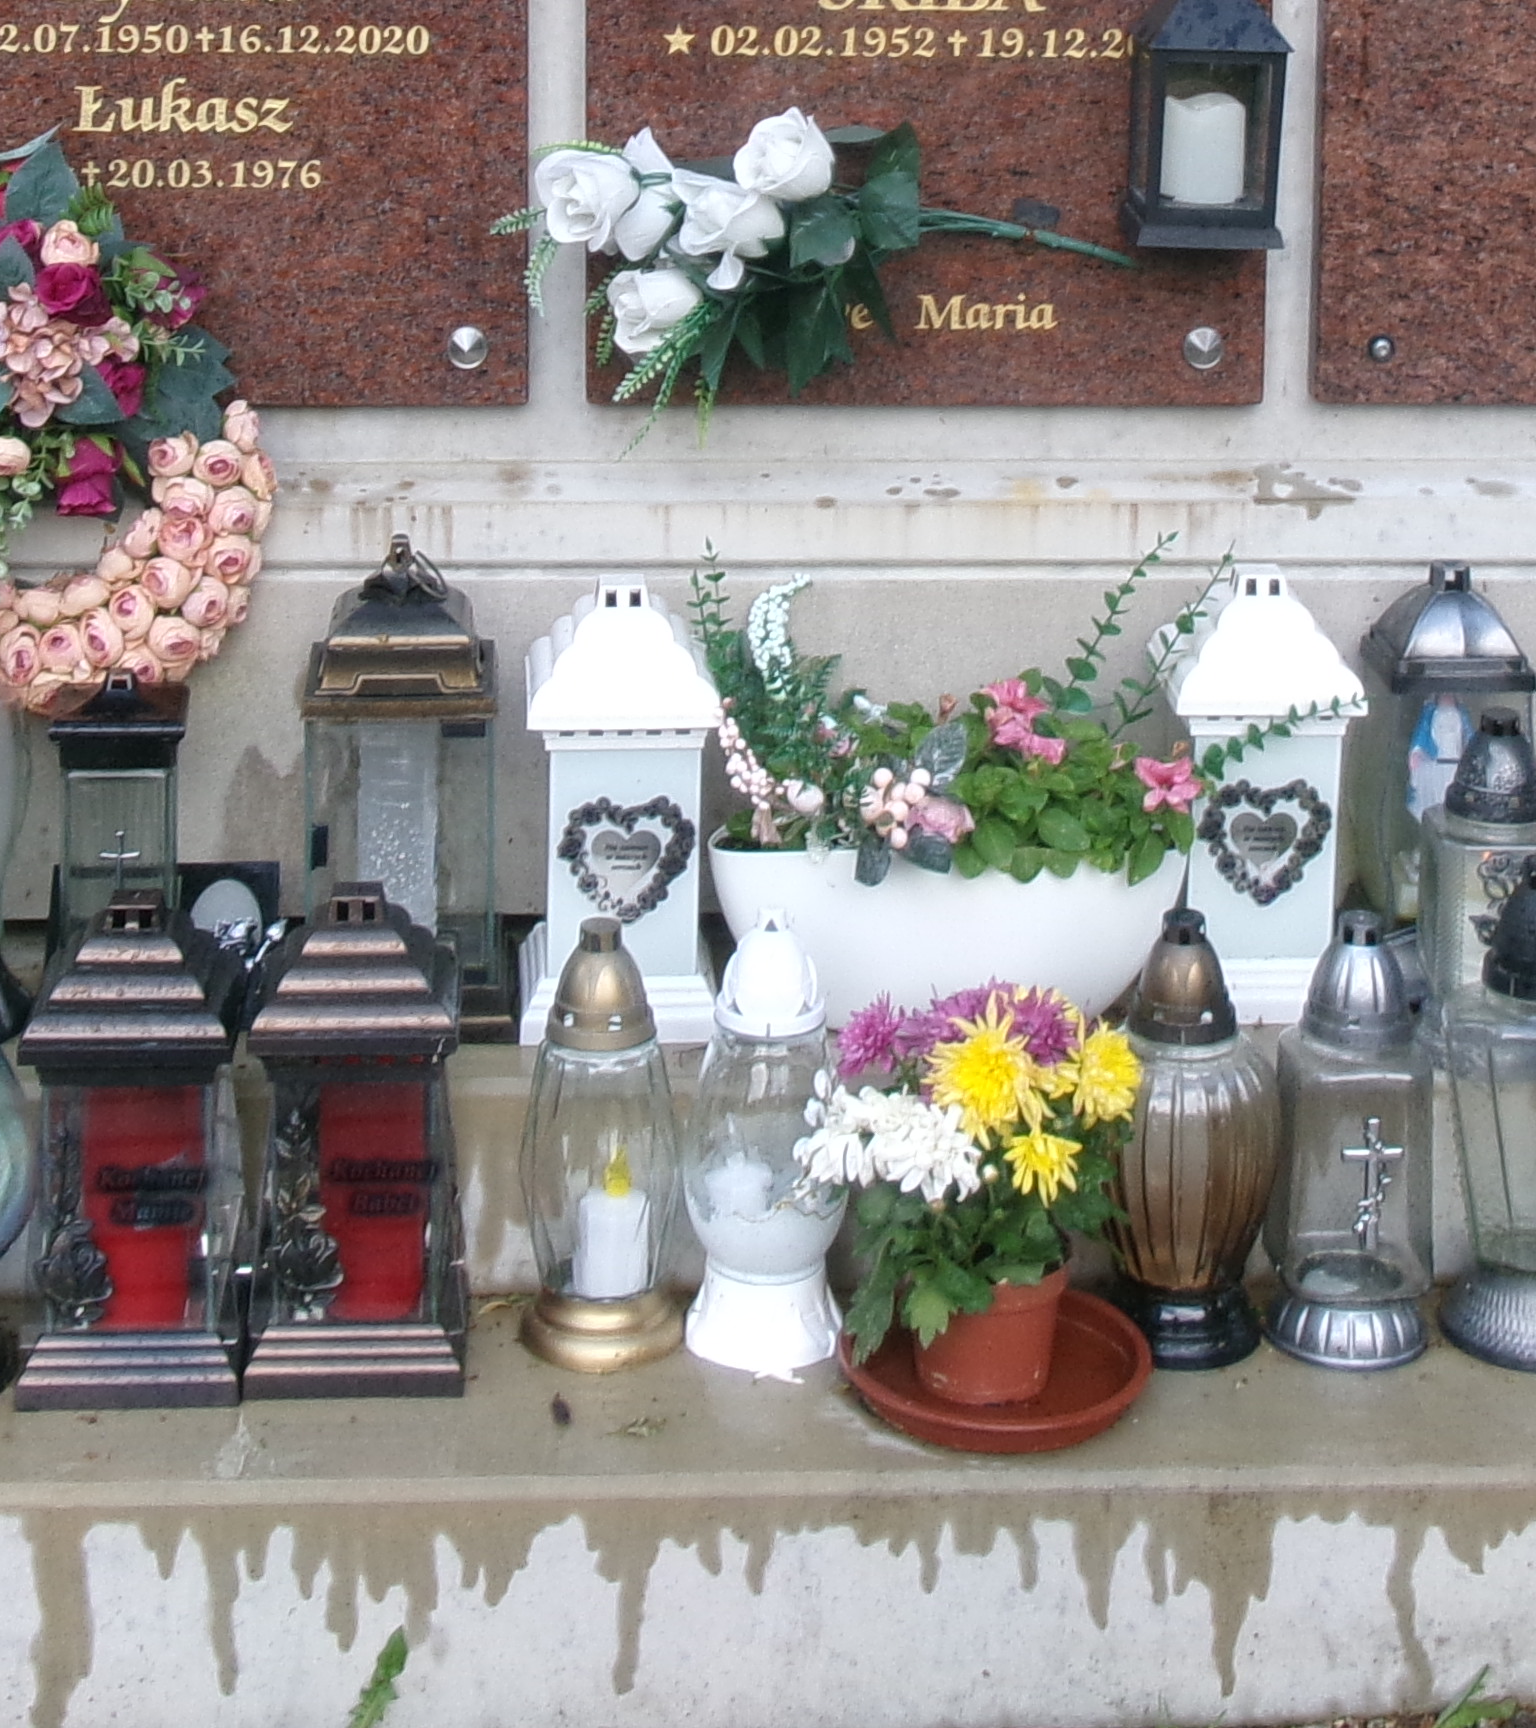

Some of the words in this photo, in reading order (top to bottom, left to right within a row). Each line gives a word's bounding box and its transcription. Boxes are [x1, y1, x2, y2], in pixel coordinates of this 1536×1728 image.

[217, 24, 430, 55] 16.12.2020
[710, 25, 937, 58] 02.02.1952
[976, 27, 1150, 59] 19.12.2
[71, 77, 294, 133] Łukasz
[106, 158, 321, 189] 20.03.1976
[915, 293, 1058, 330] Maria
